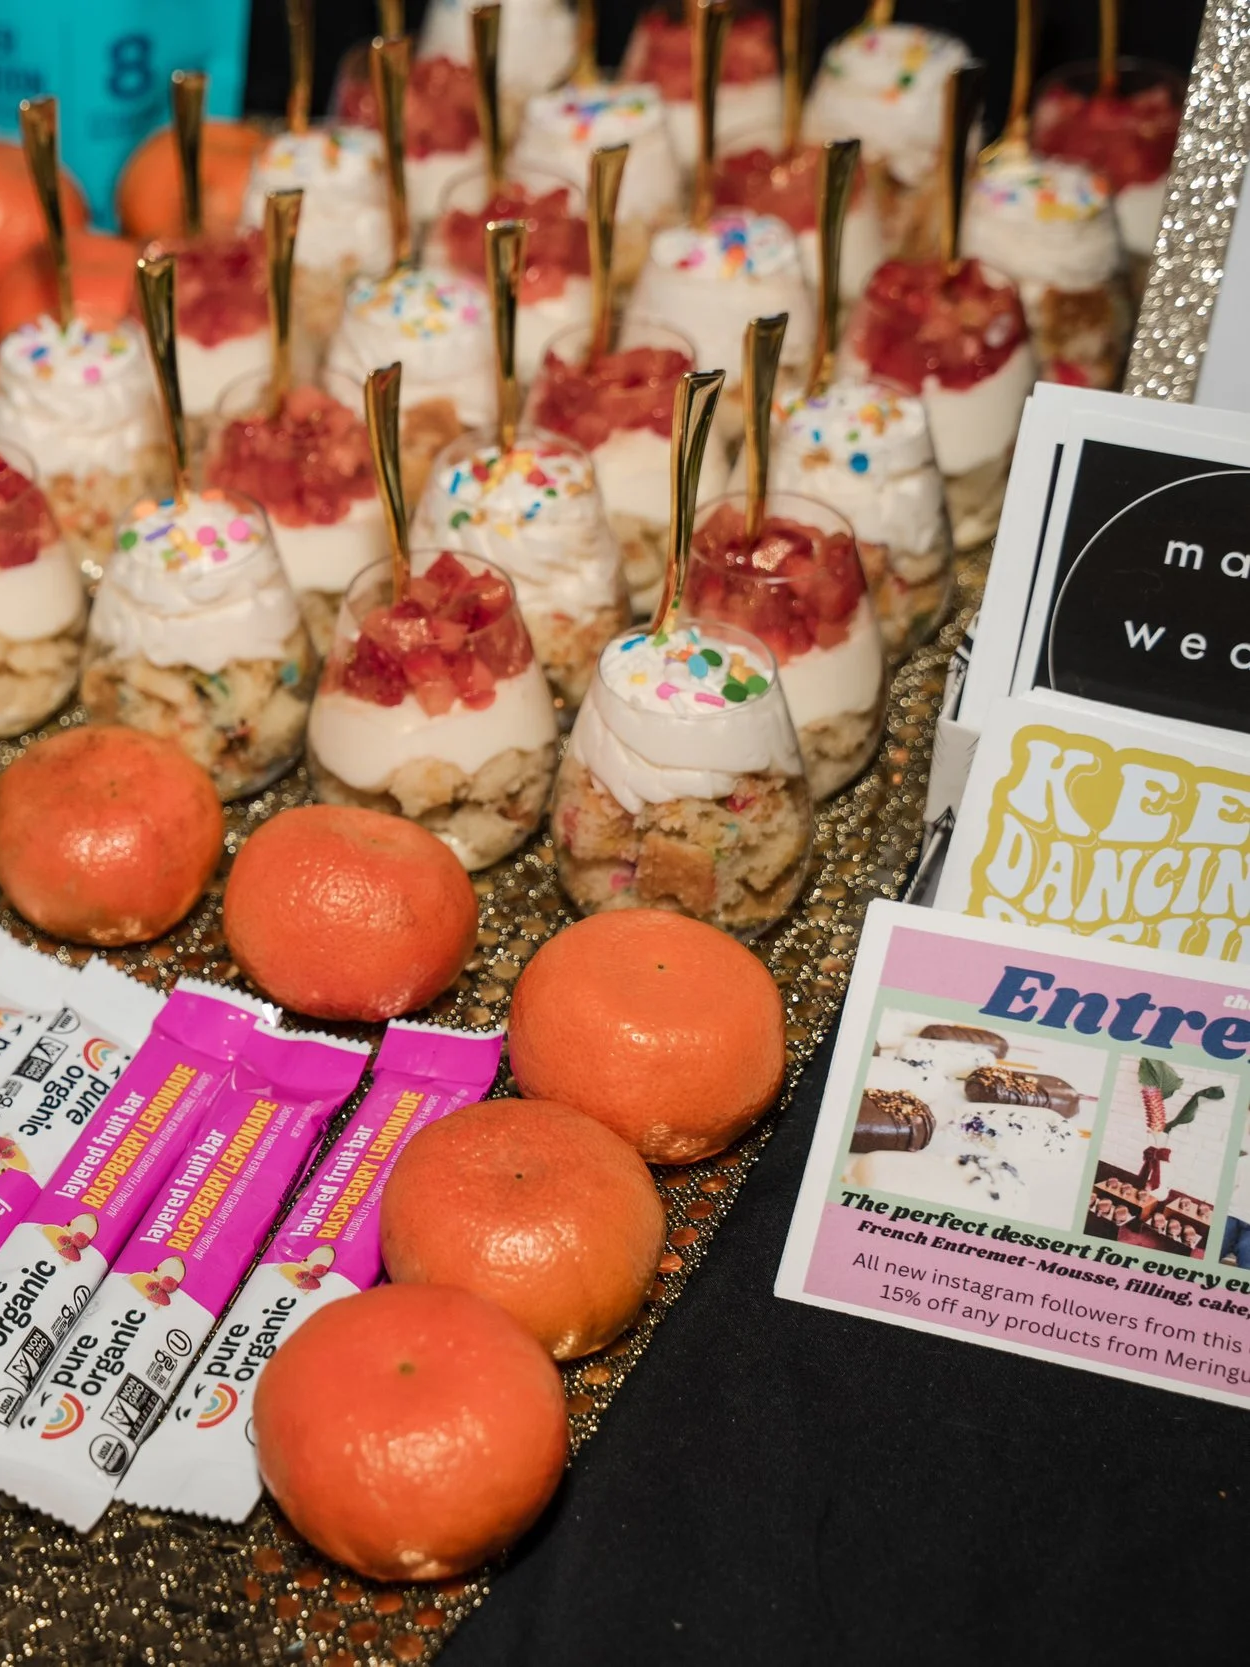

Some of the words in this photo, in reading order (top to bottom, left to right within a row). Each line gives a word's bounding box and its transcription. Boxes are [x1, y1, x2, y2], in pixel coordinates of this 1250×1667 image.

[108, 33, 153, 98] 8
[1007, 739, 1250, 846] KEE
[985, 812, 1250, 923] DANCIN
[19, 1065, 91, 1136] organic
[66, 1074, 110, 1125] pure
[82, 1129, 147, 1208] RASPBERRY
[136, 1064, 196, 1132] LEMONADE
[55, 1146, 104, 1198] layered
[92, 1108, 129, 1153] fruit
[114, 1091, 145, 1116] bar
[104, 1181, 136, 1220] NATURALLY
[127, 1151, 157, 1187] FLAVORED
[148, 1136, 167, 1157] WITH
[158, 1116, 181, 1143] OTHER
[172, 1092, 198, 1124] NATURAL
[189, 1068, 215, 1099] FLAVORS
[140, 1180, 189, 1243] layered
[174, 1154, 211, 1187] fruit
[196, 1129, 226, 1156] bar
[168, 1170, 230, 1250] RASPBERRY
[218, 1100, 276, 1173] LEMONADE
[290, 1184, 338, 1236] layered
[324, 1144, 359, 1189] fruit
[343, 1124, 374, 1154] bar
[317, 1160, 378, 1246] RASPBERRY
[367, 1091, 423, 1160] LEMONADE
[841, 1191, 889, 1214] The
[889, 1206, 988, 1236] perfect
[991, 1225, 1091, 1259] dessert
[1093, 1246, 1139, 1269] for
[1142, 1261, 1221, 1290] every
[858, 1220, 928, 1245] French
[931, 1236, 1118, 1289] Entremet-Mousse,
[1125, 1278, 1192, 1306] filling,
[1198, 1298, 1250, 1320] cake,
[23, 1330, 43, 1354] NON
[226, 1297, 296, 1382] organic
[852, 1252, 879, 1271] All
[884, 1262, 927, 1281] new
[932, 1269, 1034, 1306] instagram
[1041, 1293, 1138, 1330] followers
[1145, 1316, 1196, 1343] from
[1203, 1332, 1242, 1353] this
[880, 1284, 921, 1306] 15%
[927, 1296, 959, 1314] off
[961, 1306, 1000, 1328] any
[1004, 1316, 1100, 1348] products
[1107, 1335, 1158, 1361] from
[29, 1335, 51, 1360] GMO
[50, 1335, 98, 1396] pure
[71, 1310, 146, 1396] organic
[118, 1376, 139, 1401] NON
[204, 1324, 250, 1387] pure
[125, 1381, 146, 1406] GMO
[127, 1394, 159, 1437] VERIFIED
